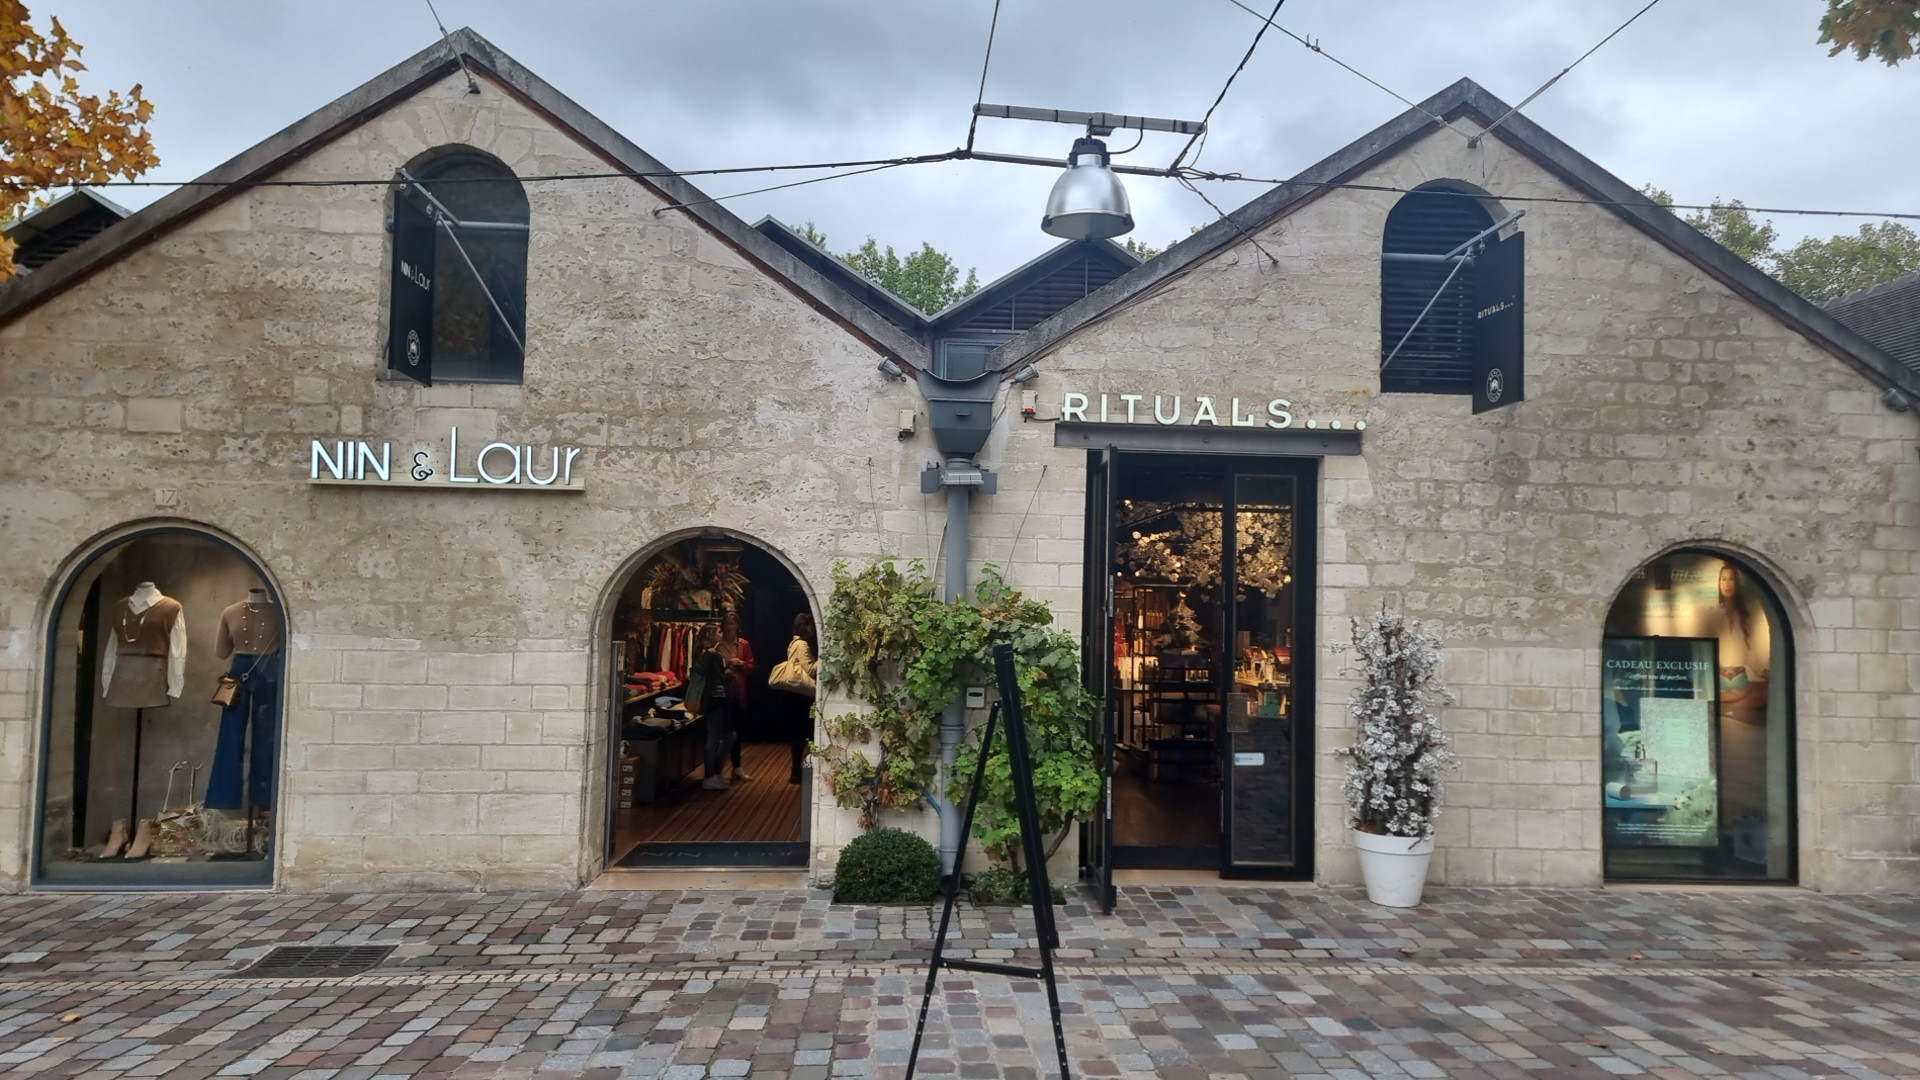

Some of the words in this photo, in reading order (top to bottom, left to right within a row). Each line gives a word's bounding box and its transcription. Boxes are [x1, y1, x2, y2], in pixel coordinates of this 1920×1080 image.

[415, 264, 431, 291] Laur
[311, 440, 391, 481] NIN
[411, 451, 434, 482] &
[449, 426, 582, 485] Laur
[161, 489, 176, 504] 17
[1606, 659, 1652, 669] CADEAU
[1656, 660, 1710, 671] EXCLUSIF
